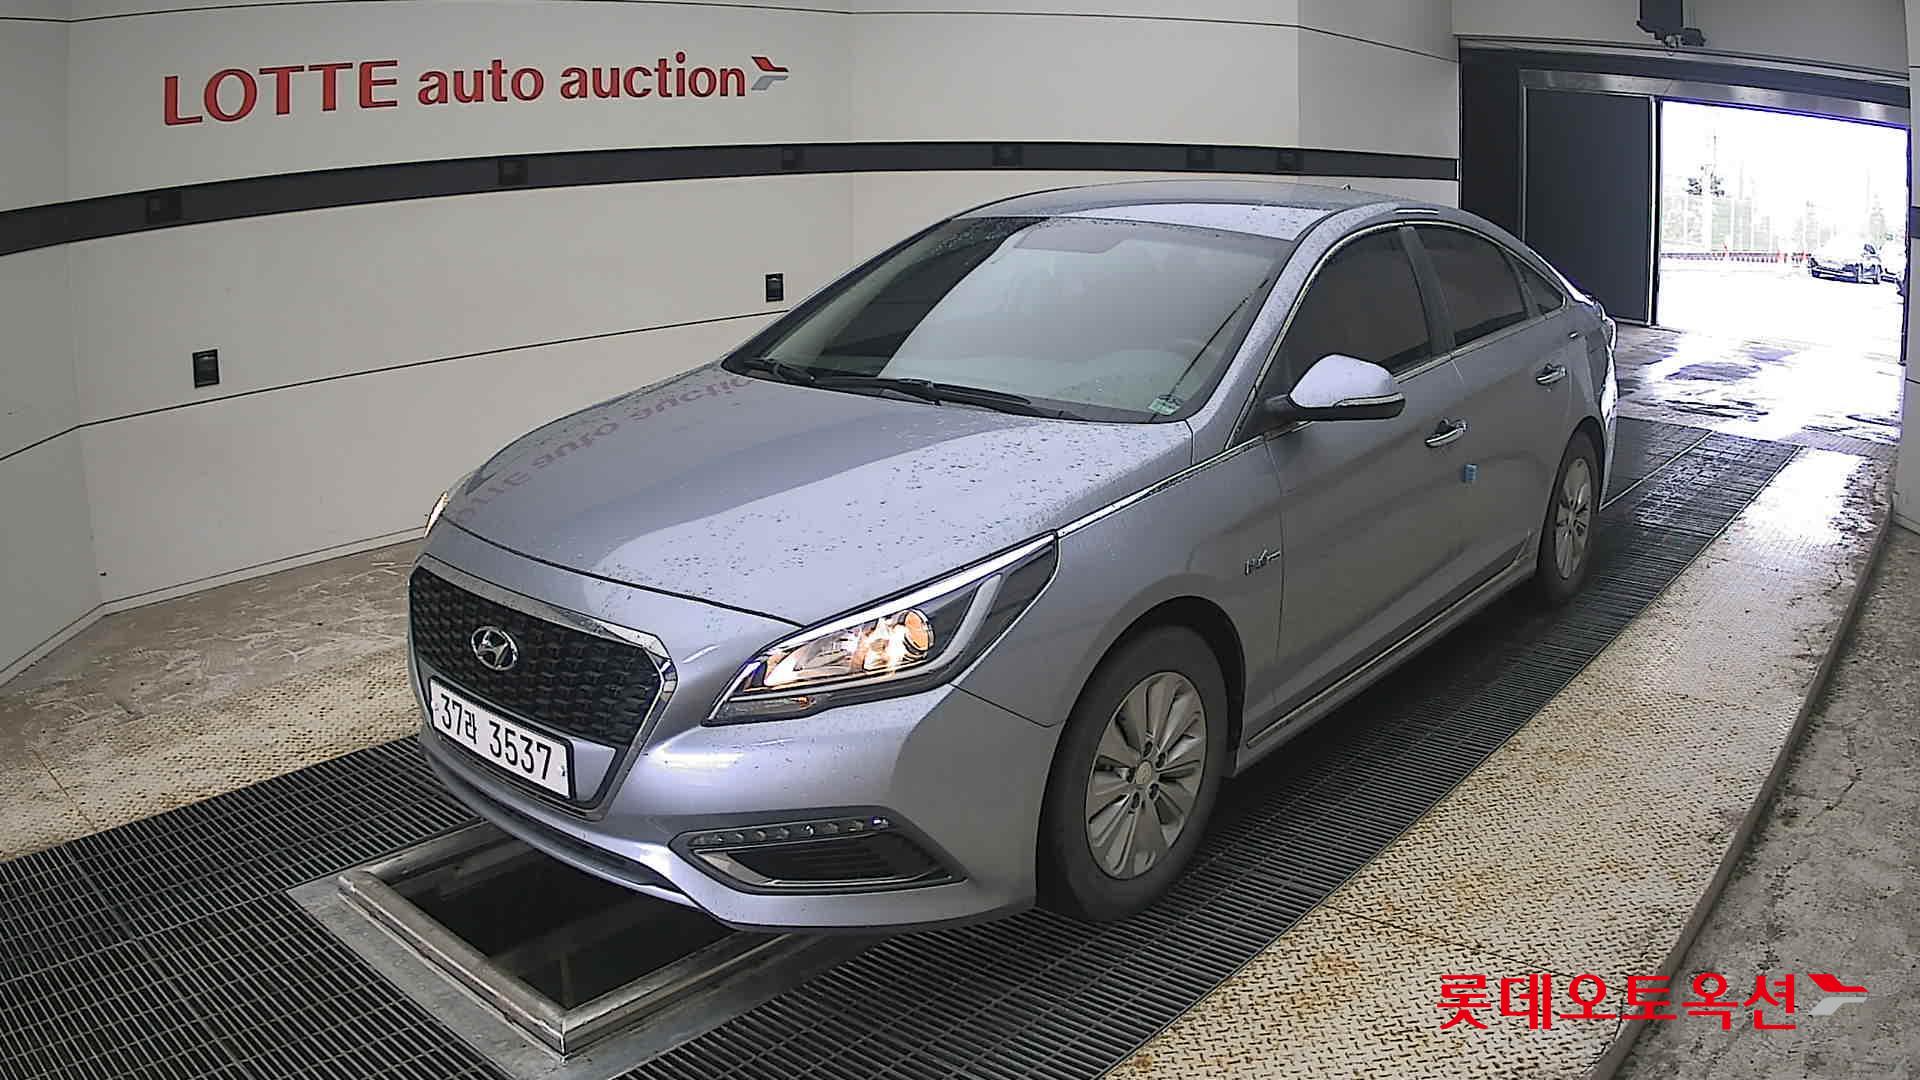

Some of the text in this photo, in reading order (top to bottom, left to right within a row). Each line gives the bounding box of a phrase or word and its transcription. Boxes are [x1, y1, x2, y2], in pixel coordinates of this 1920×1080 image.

[164, 52, 748, 125] LOTTE auto auction
[440, 693, 552, 780] 37라 3537
